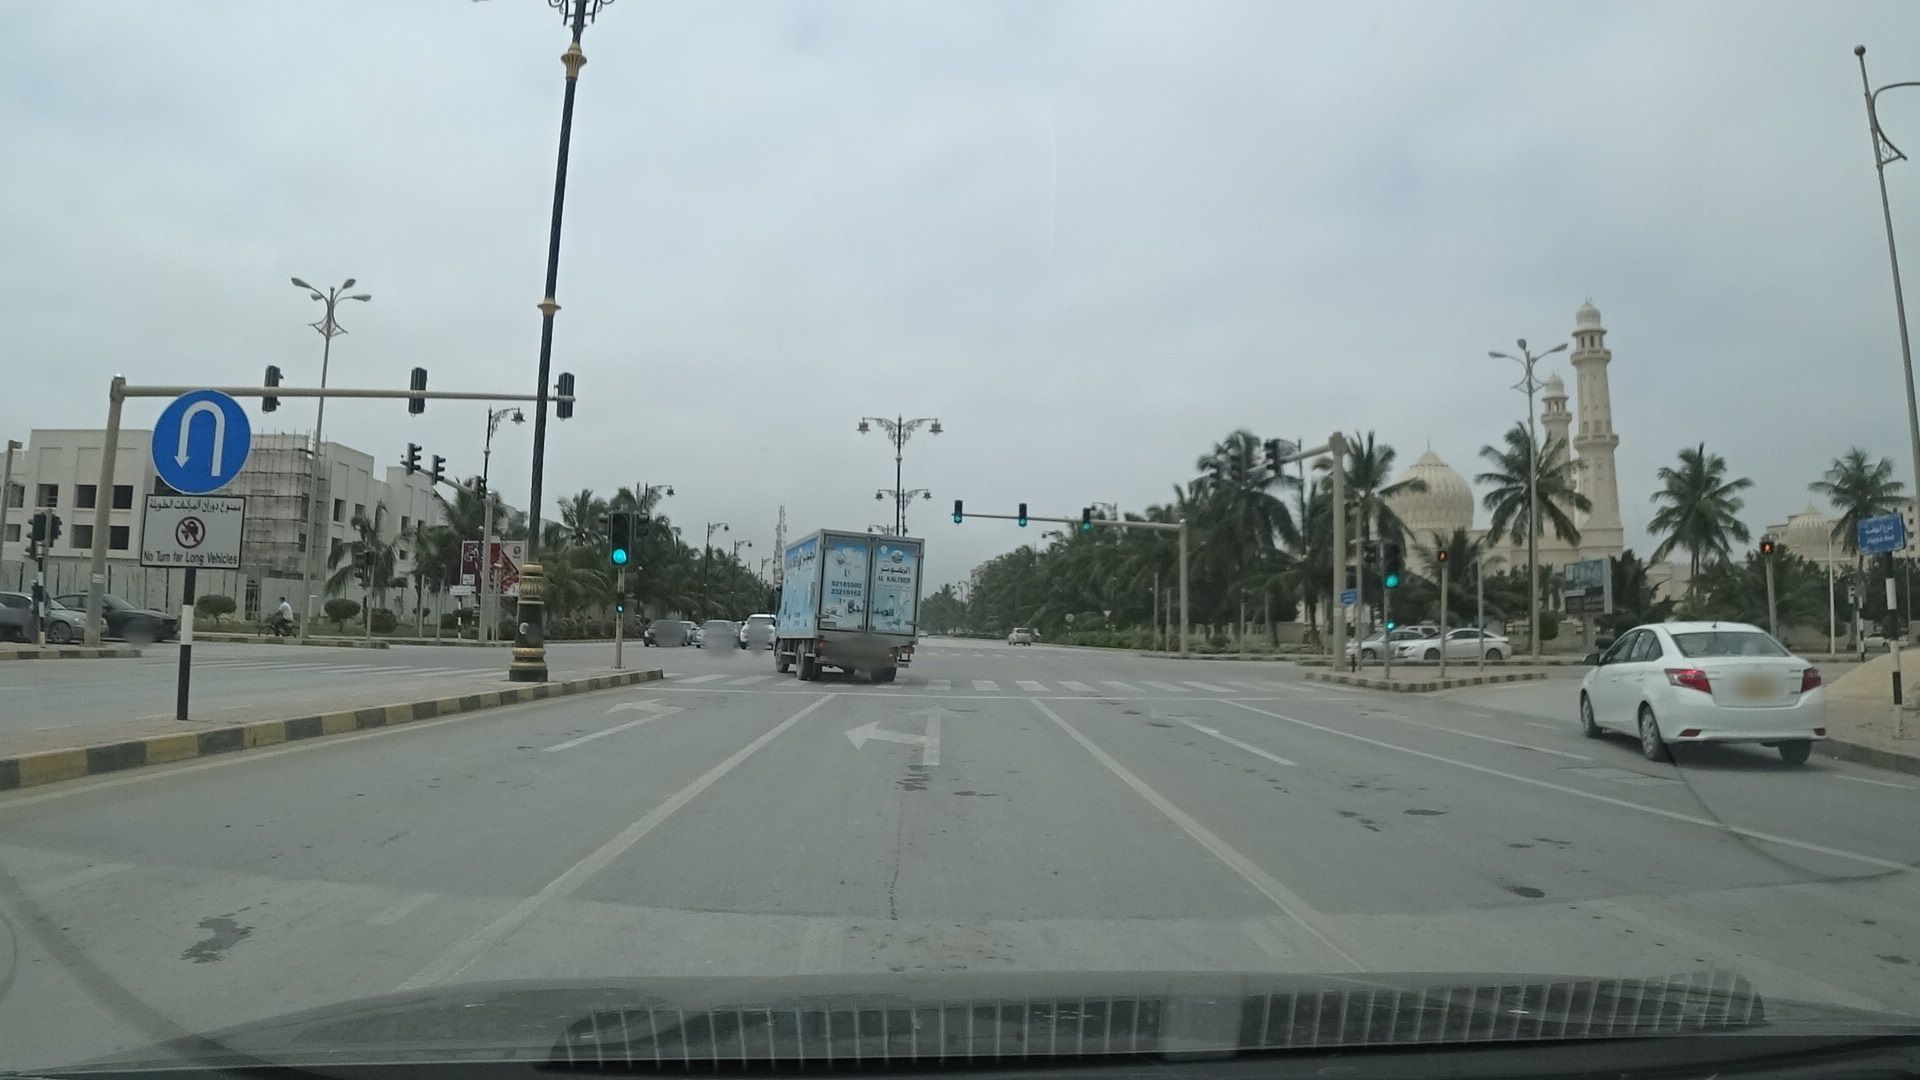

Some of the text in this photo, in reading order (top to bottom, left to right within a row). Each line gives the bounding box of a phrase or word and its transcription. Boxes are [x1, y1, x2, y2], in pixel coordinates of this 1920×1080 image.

[144, 550, 238, 565] No Turn for Long Vehicles
